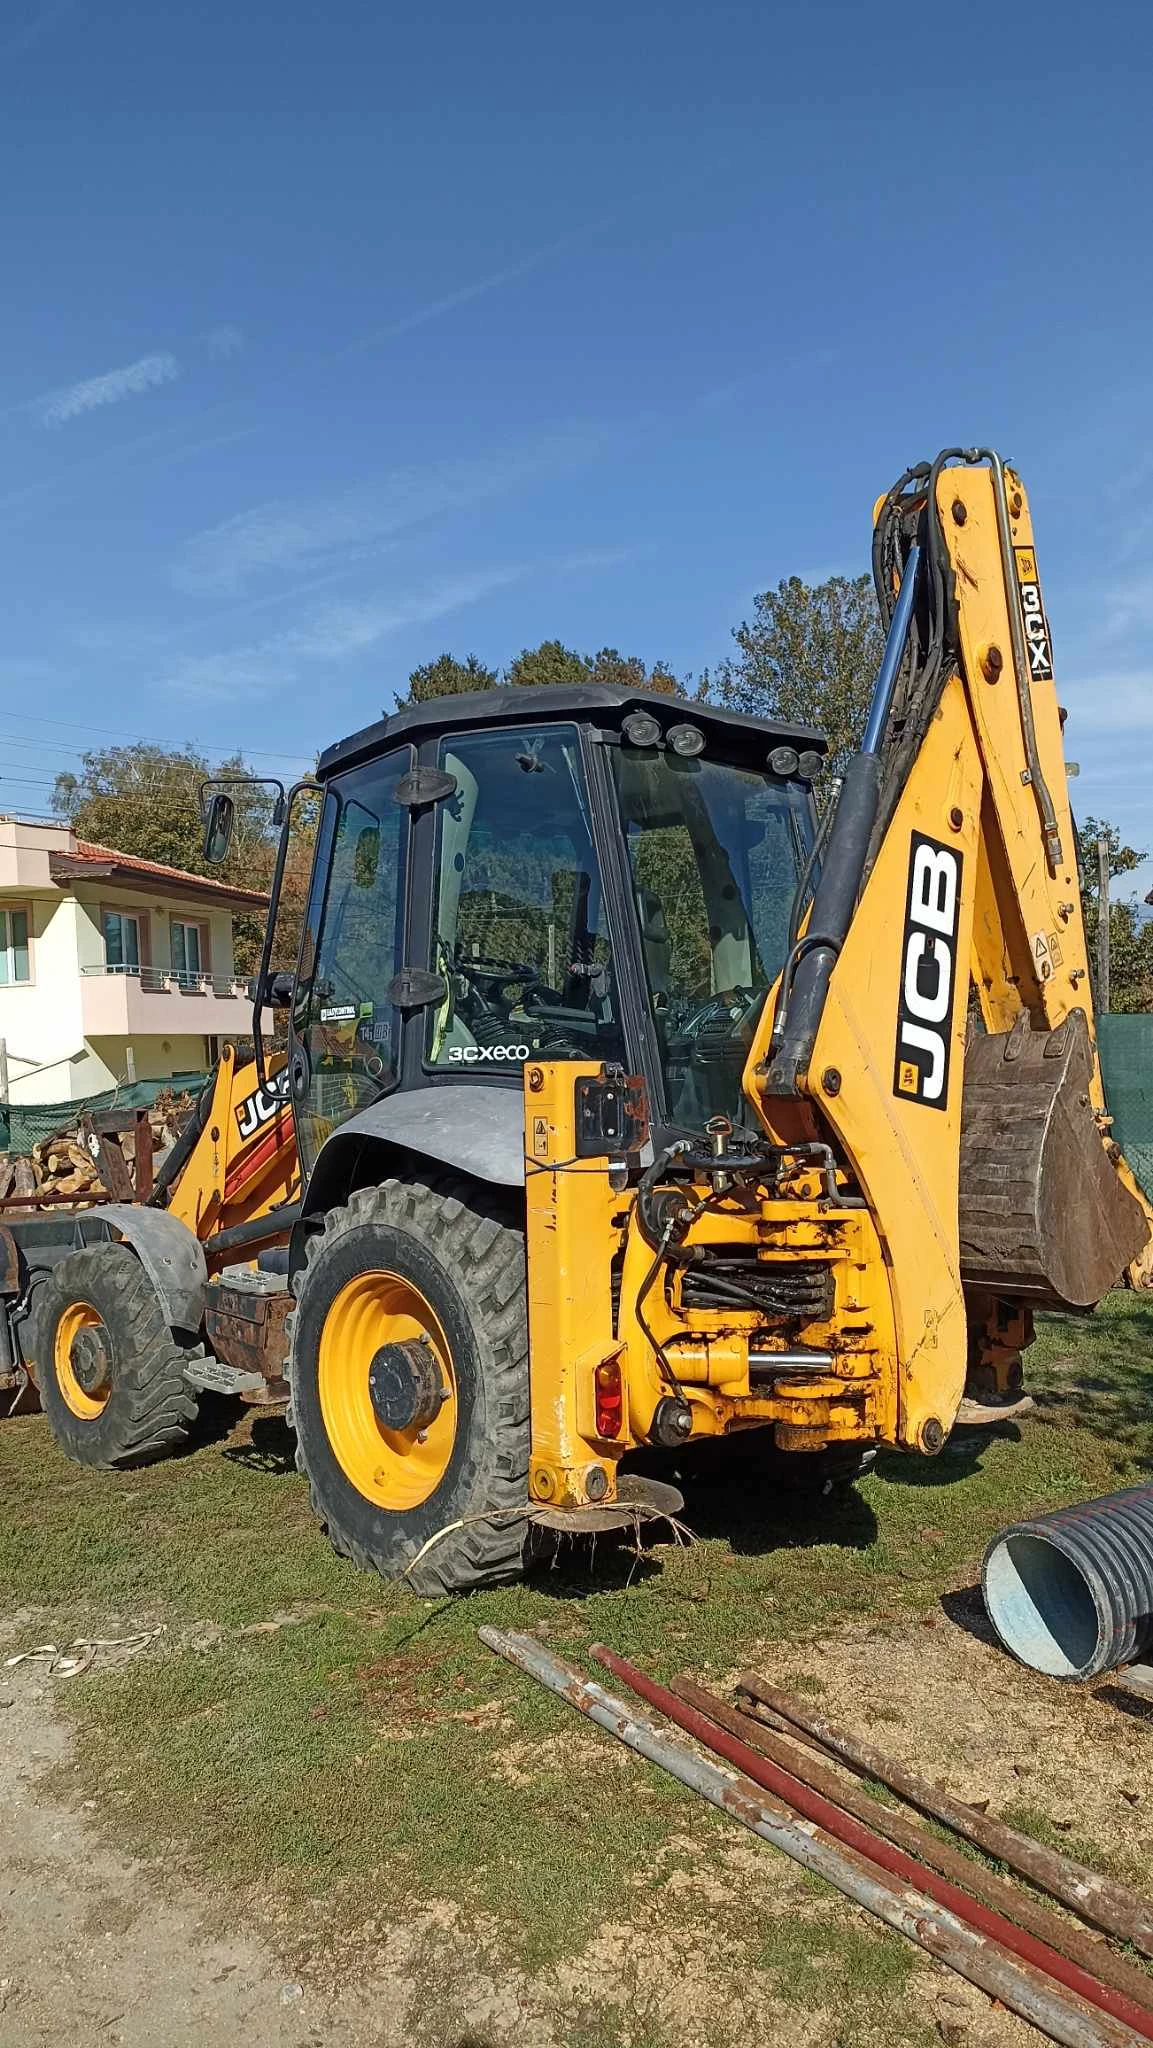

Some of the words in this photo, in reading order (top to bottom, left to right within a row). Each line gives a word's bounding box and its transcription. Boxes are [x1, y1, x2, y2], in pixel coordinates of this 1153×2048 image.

[1021, 585, 1051, 669] 3CX
[902, 844, 958, 1099] JCB
[448, 1044, 530, 1061] 3CXeco
